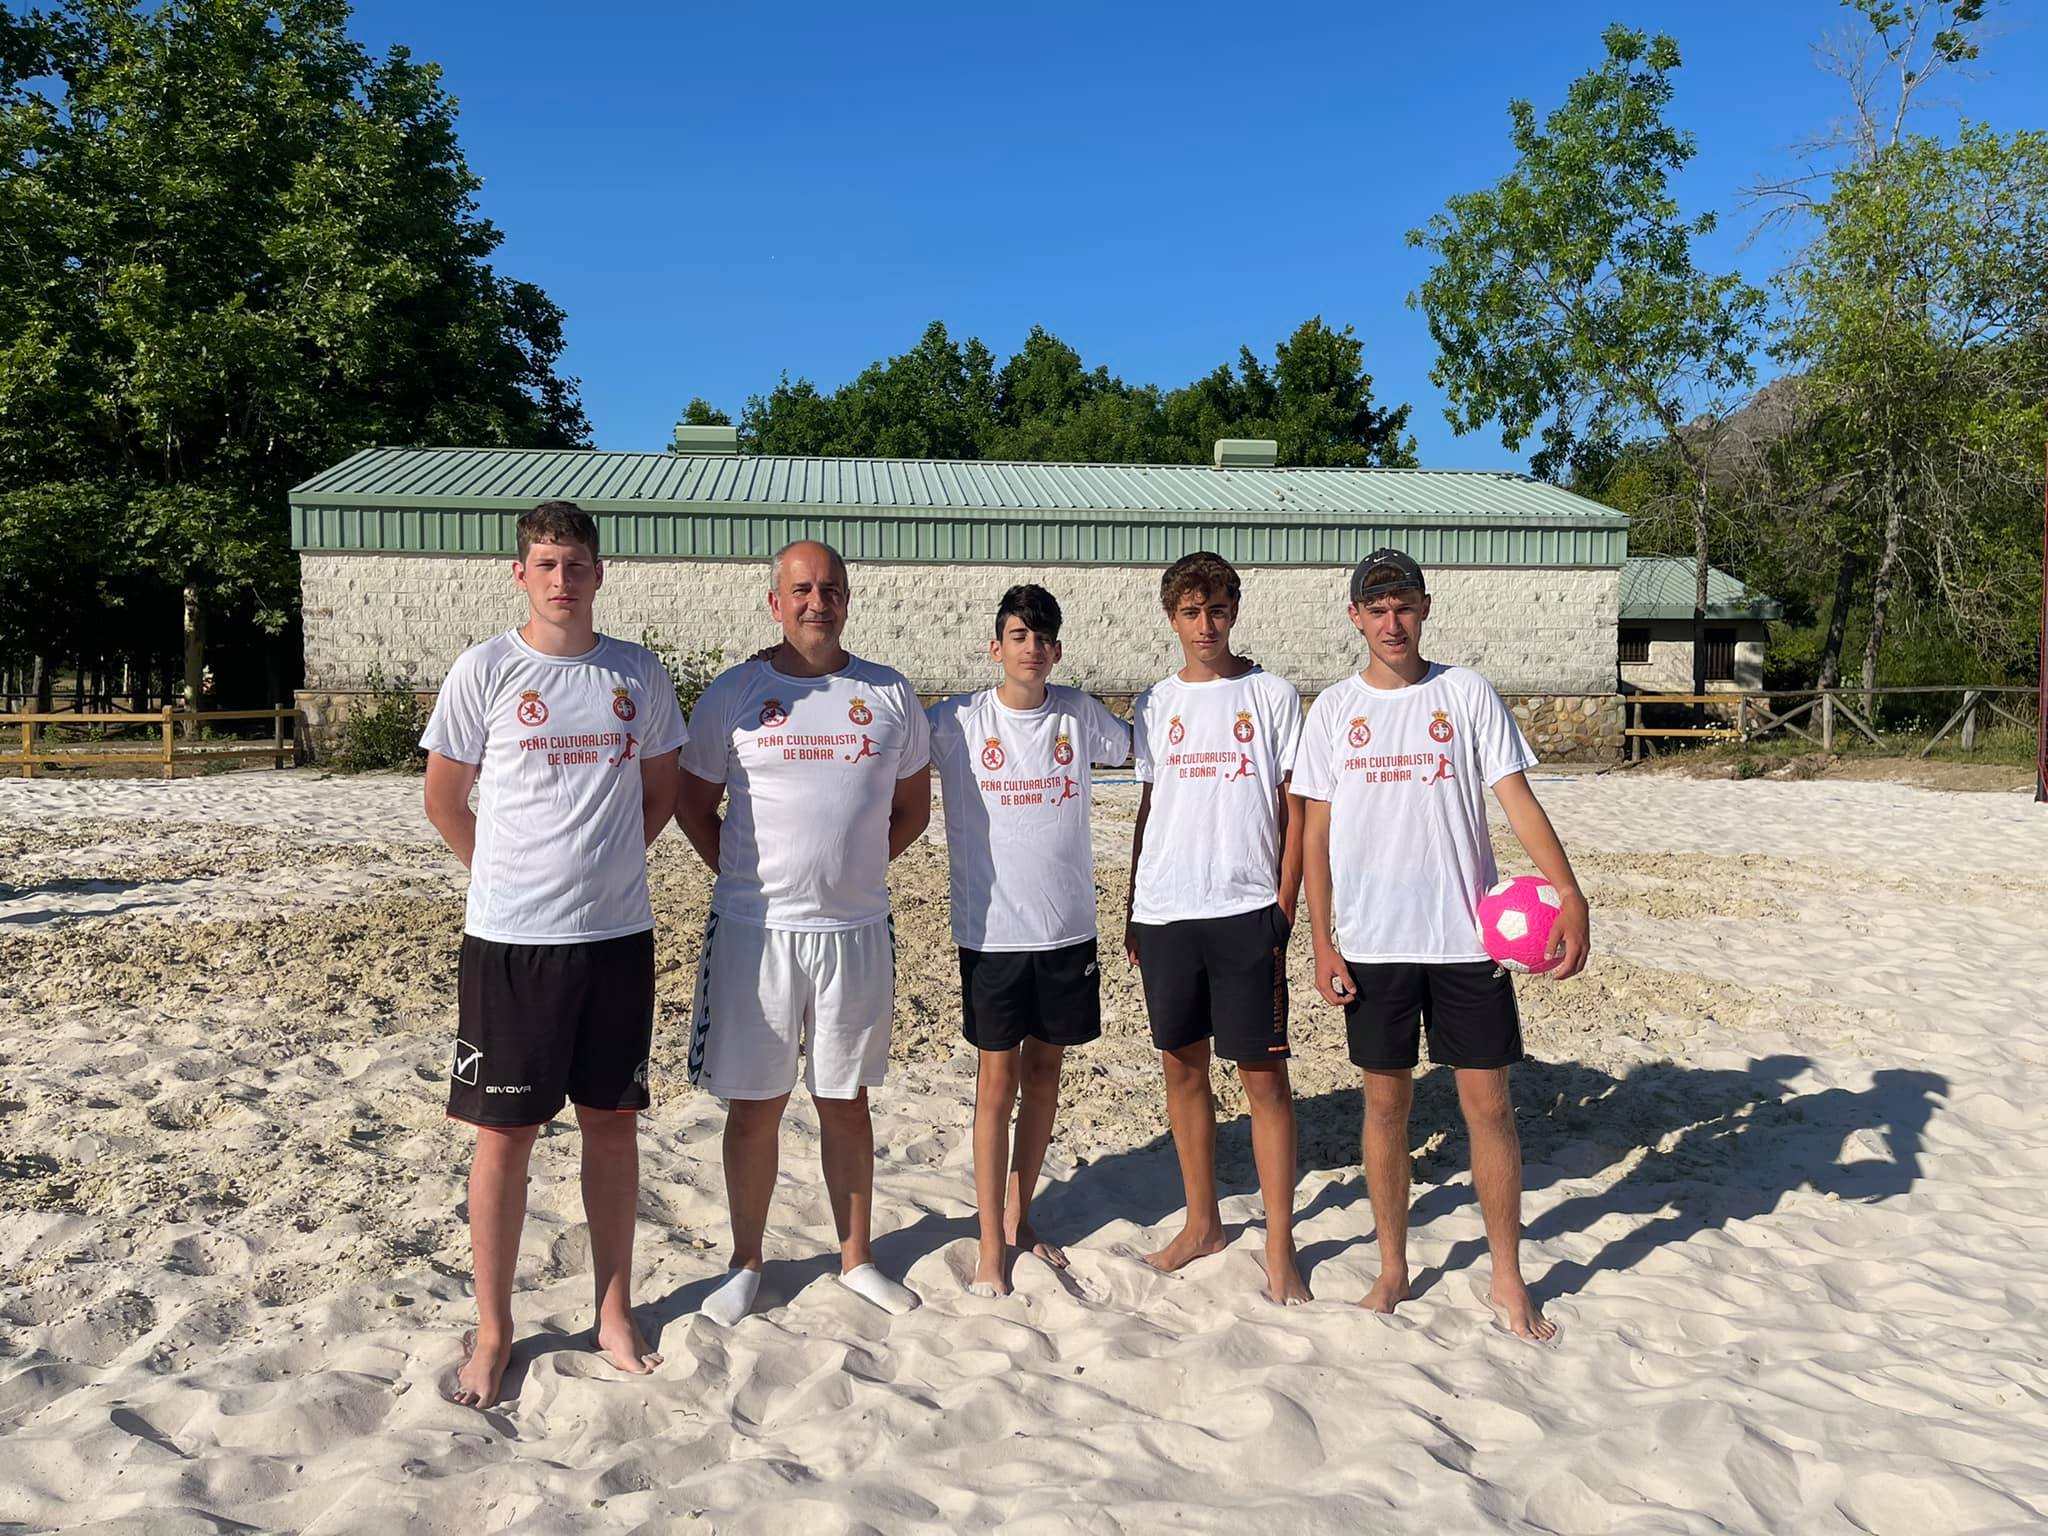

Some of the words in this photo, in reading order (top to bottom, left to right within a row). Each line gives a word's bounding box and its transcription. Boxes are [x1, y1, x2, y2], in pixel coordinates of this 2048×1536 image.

[520, 736, 547, 752] PEÑA
[550, 733, 621, 749] CULTURALISTA
[757, 734, 783, 748] PEÑA
[787, 734, 857, 746] CULTURALISTA
[548, 753, 560, 766] DE
[563, 750, 598, 765] BOÑAR
[783, 749, 796, 760] DE
[799, 748, 834, 760] BOÑAR
[1182, 752, 1237, 764] CULTURALISTA
[1344, 756, 1367, 770] PEÑA
[1369, 753, 1434, 768] CULTURALISTA
[1180, 768, 1188, 779] DE
[1189, 765, 1217, 778] BOÑAR
[1366, 772, 1378, 783] DE
[1380, 769, 1412, 783] BOÑAR
[981, 779, 1001, 791] PEÑA
[1003, 777, 1061, 791] CULTURALISTA
[1001, 795, 1012, 805] DE
[1014, 792, 1043, 805] BOÑAR
[485, 1085, 532, 1094] GIVOVA
